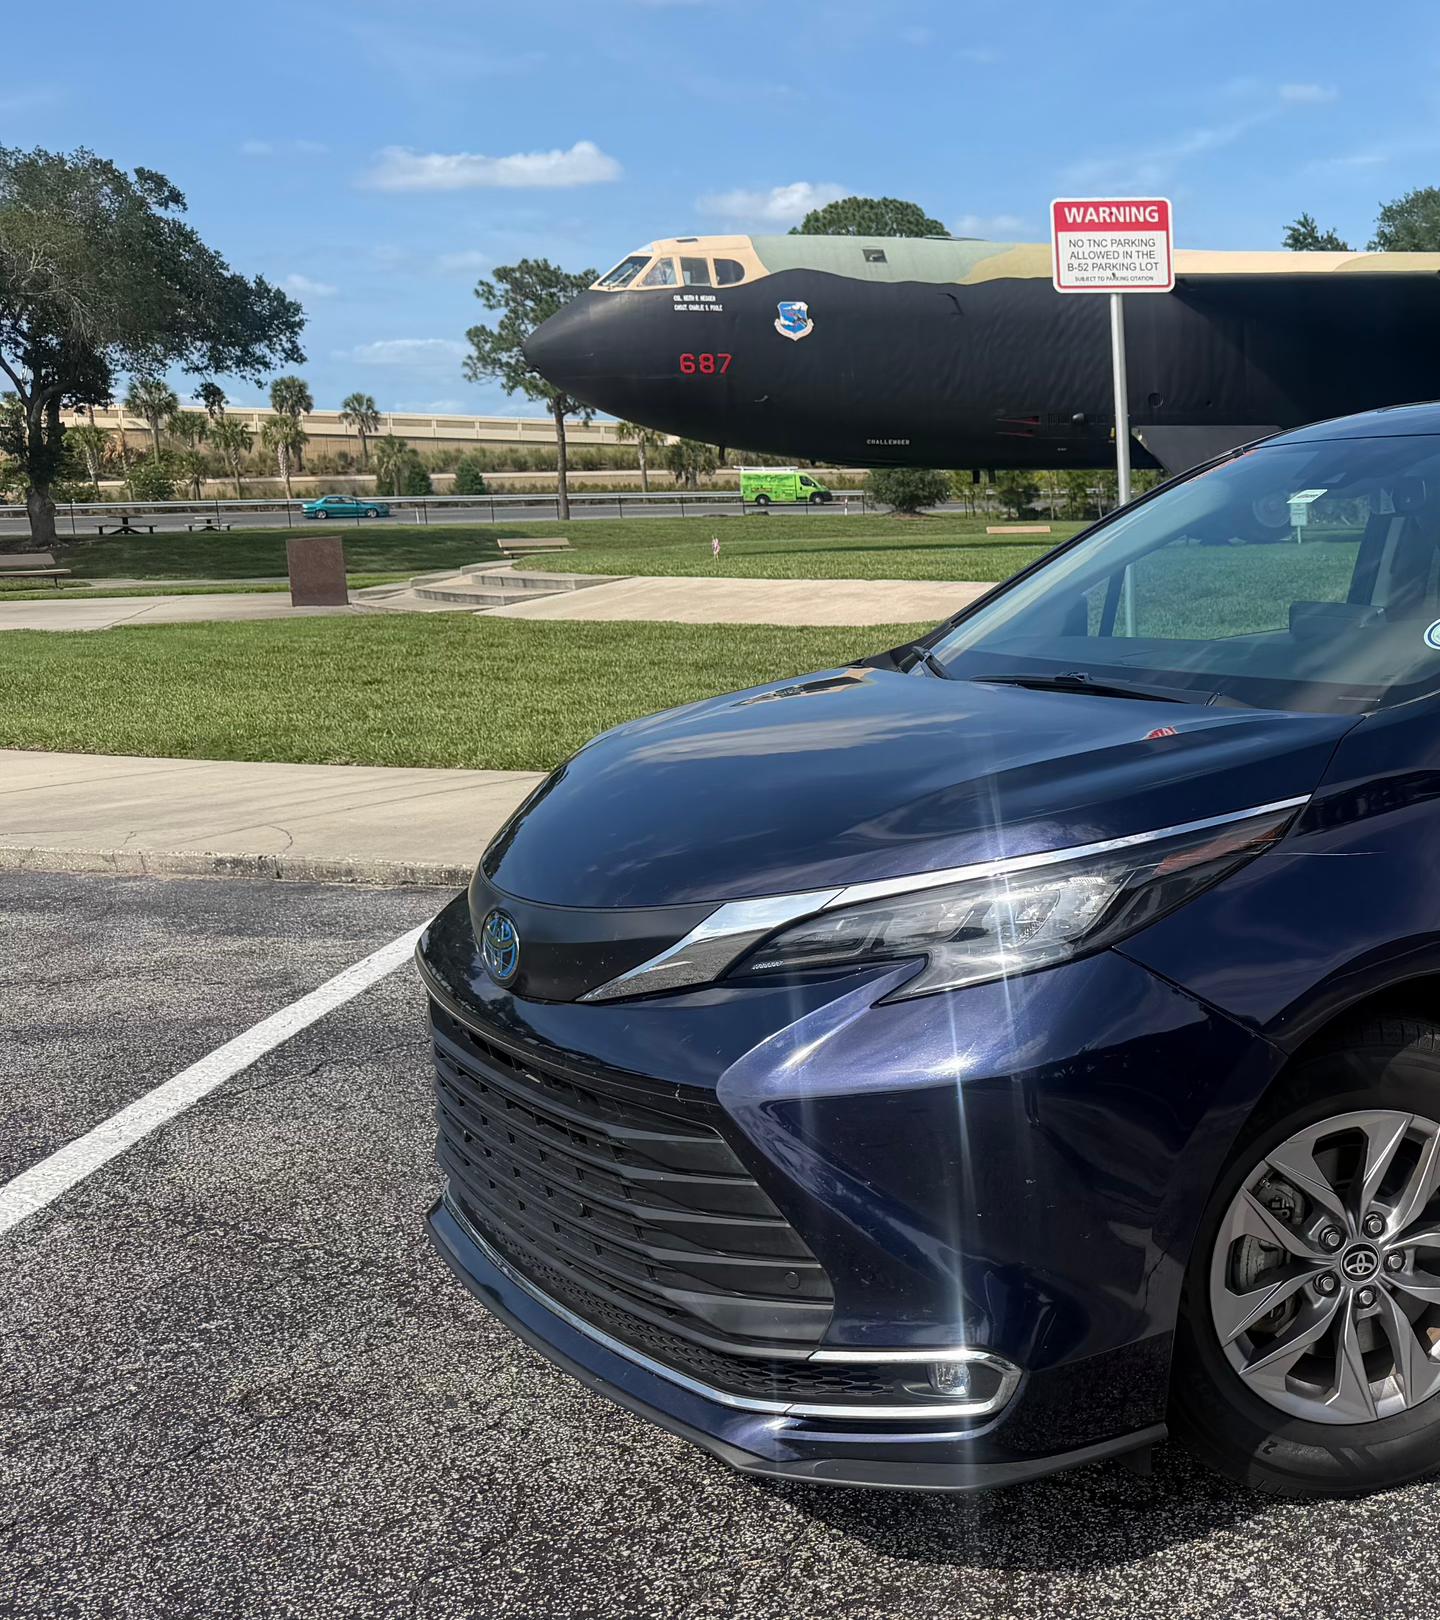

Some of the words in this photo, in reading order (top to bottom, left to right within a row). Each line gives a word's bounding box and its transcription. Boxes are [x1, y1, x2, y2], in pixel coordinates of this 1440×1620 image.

[1063, 206, 1159, 223] WARNING
[1068, 239, 1084, 248] NO
[1086, 239, 1108, 248] TNC
[1110, 238, 1156, 247] PARKING
[1069, 250, 1120, 260] ALLOWED
[1122, 250, 1133, 259] IN
[1135, 250, 1156, 259] THE
[1067, 262, 1089, 272] B-52
[1091, 262, 1137, 271] PARKING
[1139, 262, 1159, 271] LOT
[679, 352, 733, 374] 687
